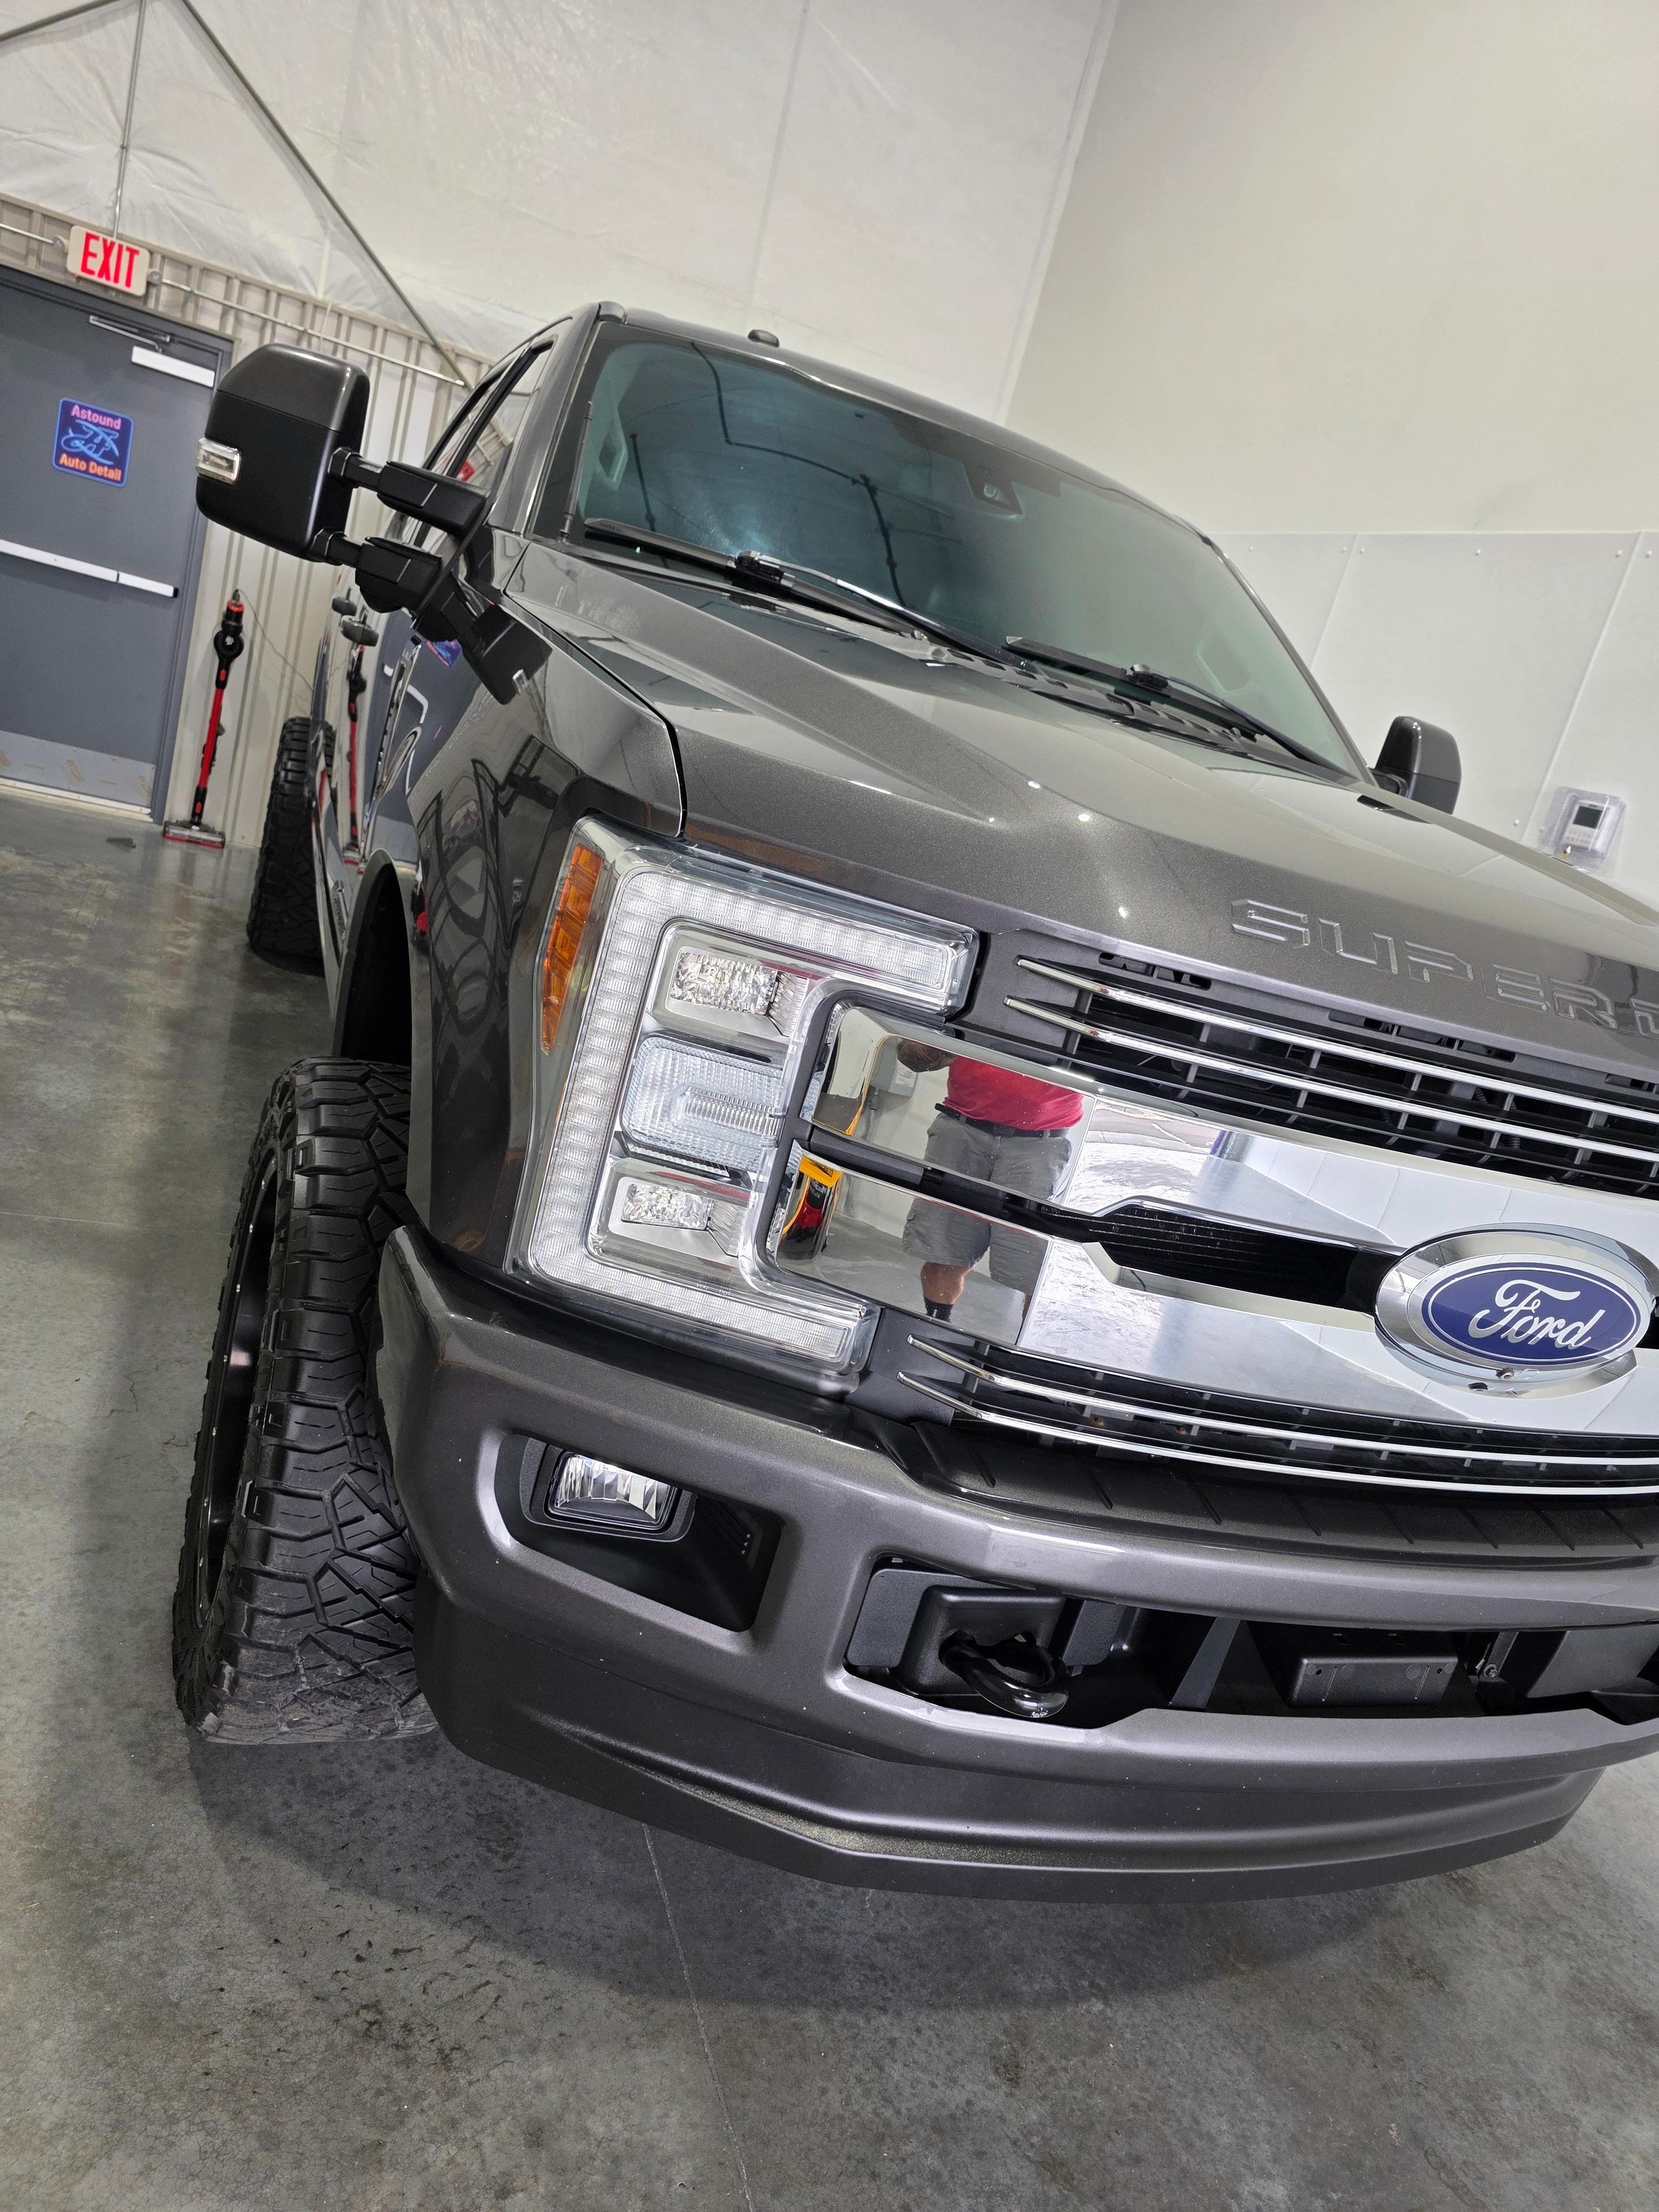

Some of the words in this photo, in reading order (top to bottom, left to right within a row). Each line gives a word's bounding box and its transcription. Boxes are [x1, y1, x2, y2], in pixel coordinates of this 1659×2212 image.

[81, 232, 140, 288] EXIT
[70, 404, 122, 430] Astound
[59, 453, 87, 471] Auto
[88, 461, 122, 482] Detail
[1230, 898, 1618, 1029] SUPER
[1468, 1279, 1606, 1350] Ford
